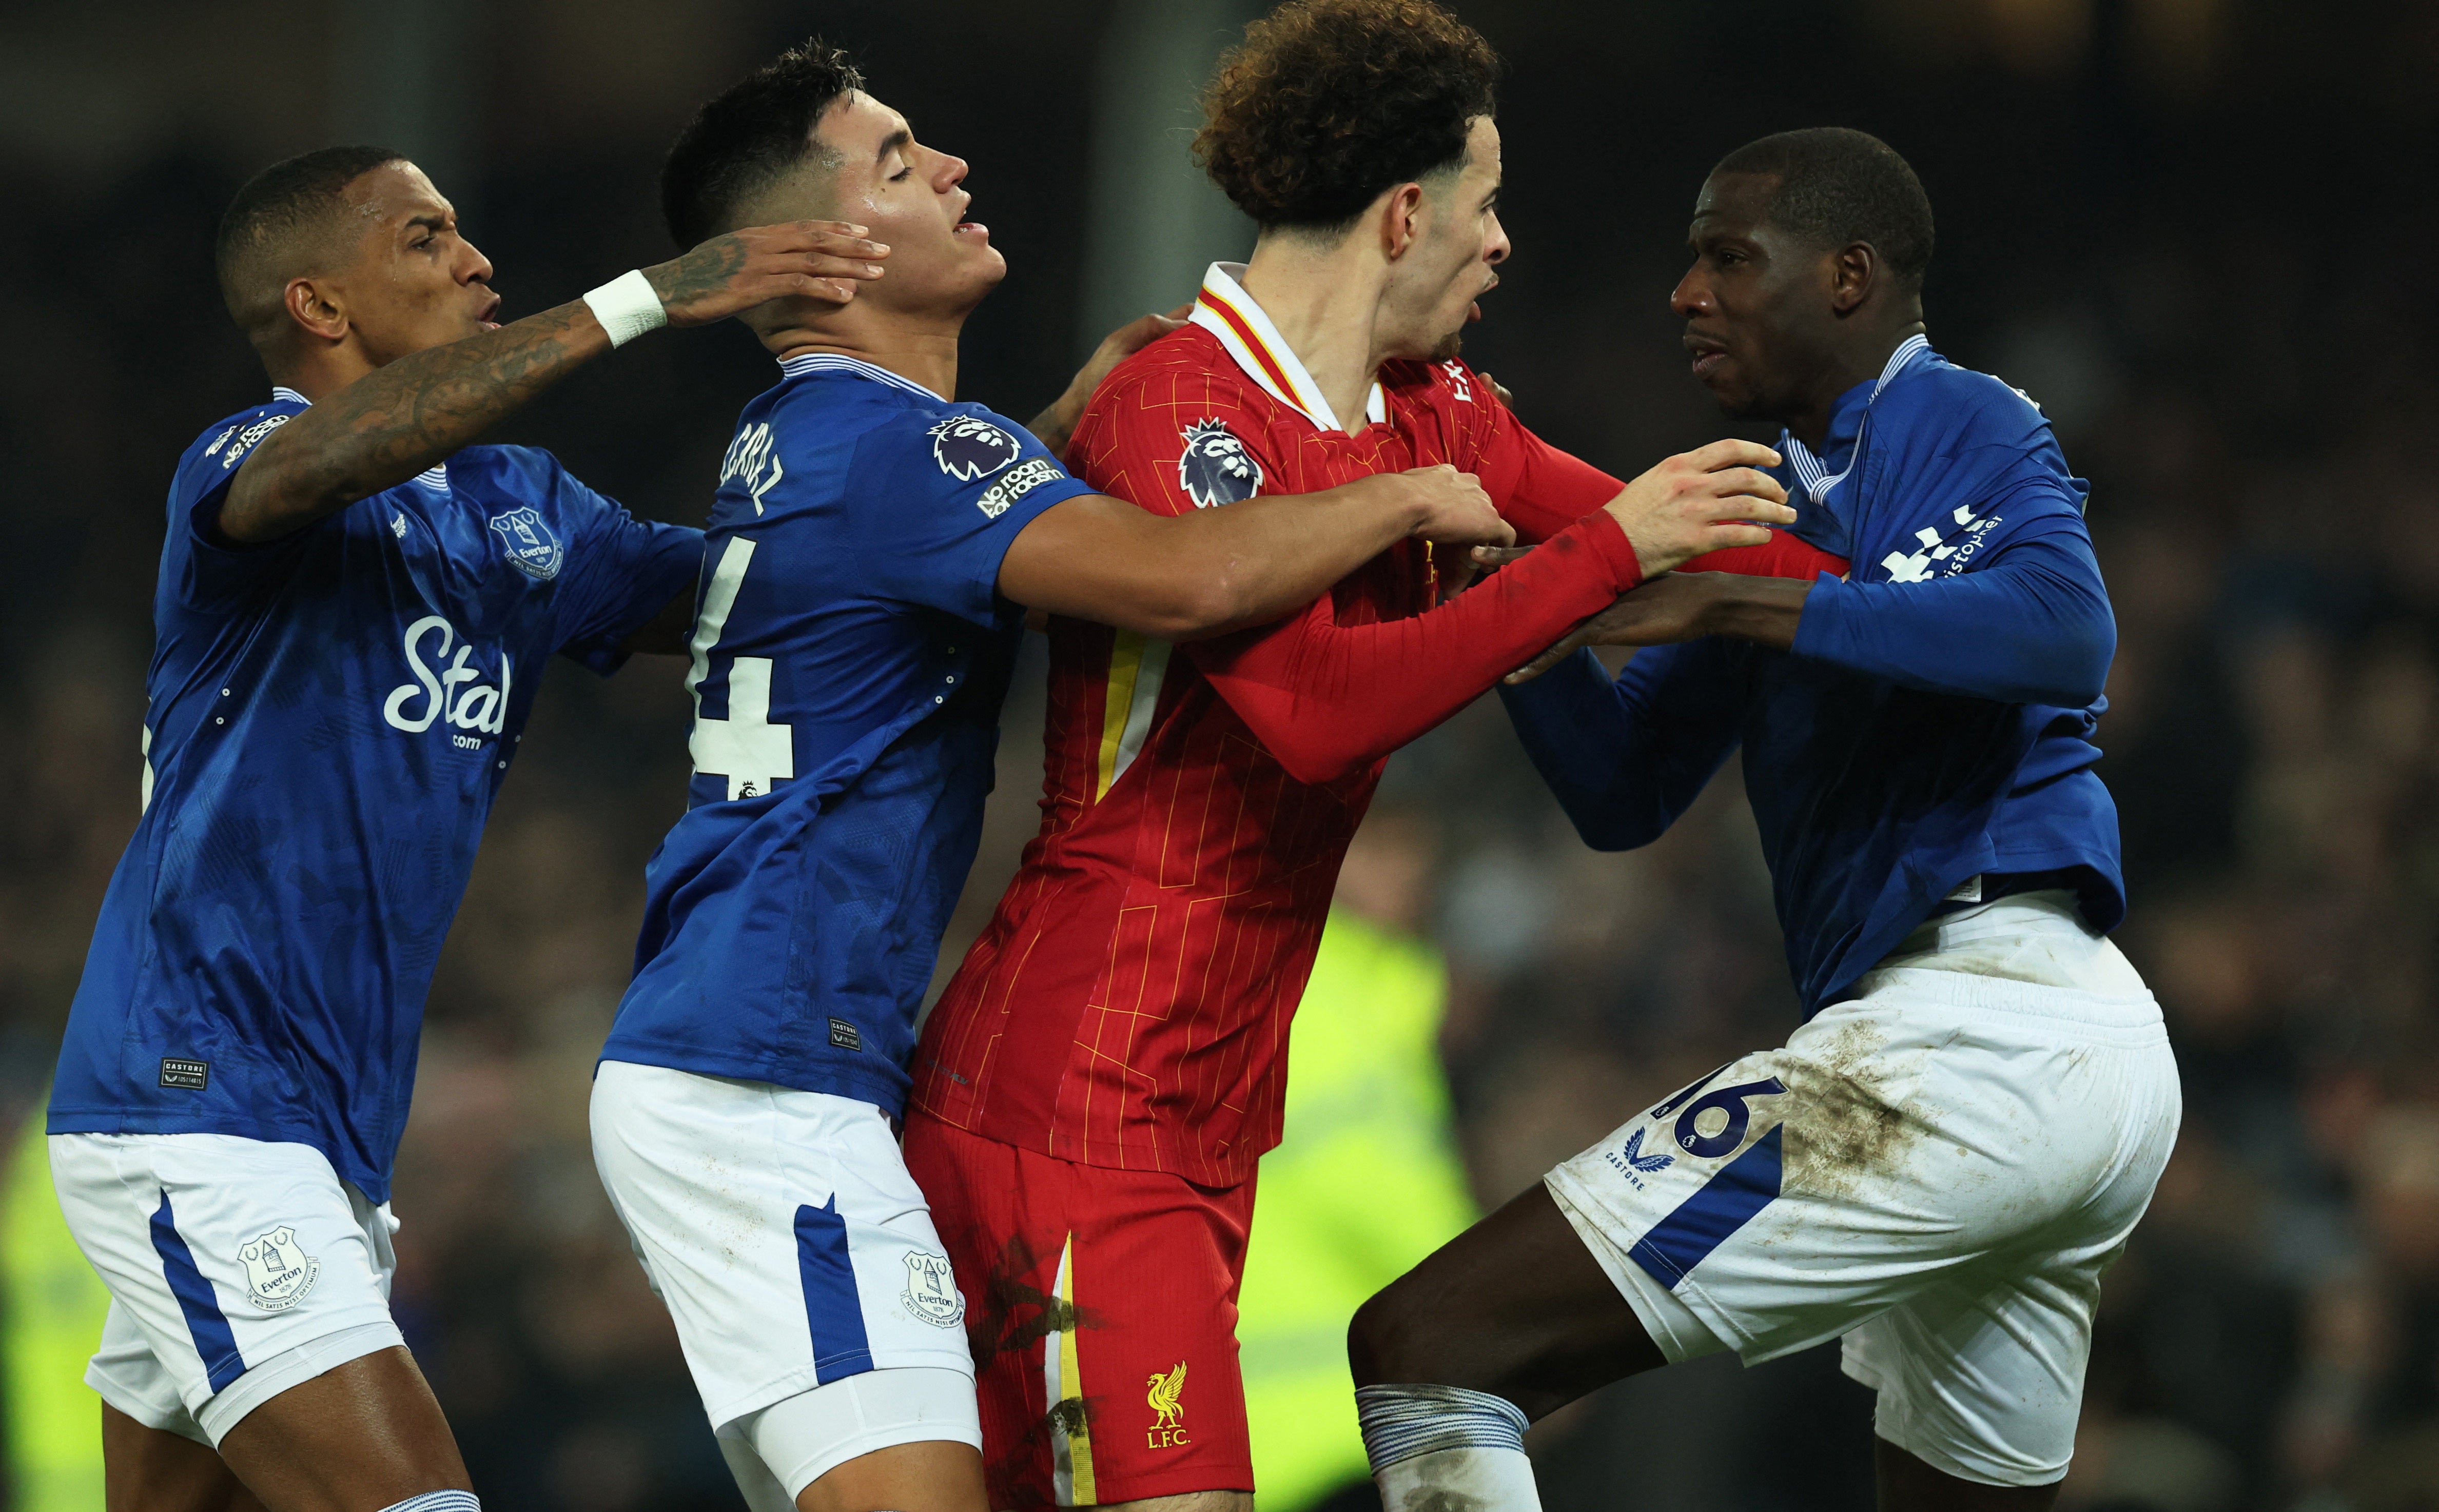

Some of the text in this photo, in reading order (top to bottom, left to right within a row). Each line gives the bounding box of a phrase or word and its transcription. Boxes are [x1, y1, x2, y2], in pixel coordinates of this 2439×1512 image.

[223, 442, 242, 469] No
[240, 415, 290, 443] room
[977, 459, 1049, 517] No room
[987, 469, 1065, 519] for racism
[519, 545, 553, 558] Everton
[684, 536, 794, 801] 4
[453, 734, 481, 750] com
[832, 1023, 856, 1034] CASTORE
[166, 1063, 203, 1072] CASTORE
[1650, 1053, 1790, 1158] 16
[1606, 1152, 1645, 1191] CASTORE
[255, 1299, 264, 1307] NIL
[285, 1295, 299, 1306] NISI
[299, 1267, 317, 1296] OPTIMUM
[261, 1267, 302, 1293] Everton
[279, 1283, 292, 1293] 1878
[918, 1292, 953, 1307] Everton
[906, 1301, 915, 1312] NIL
[916, 1311, 933, 1322] SATIS
[1147, 1429, 1191, 1449] L.F.C.
